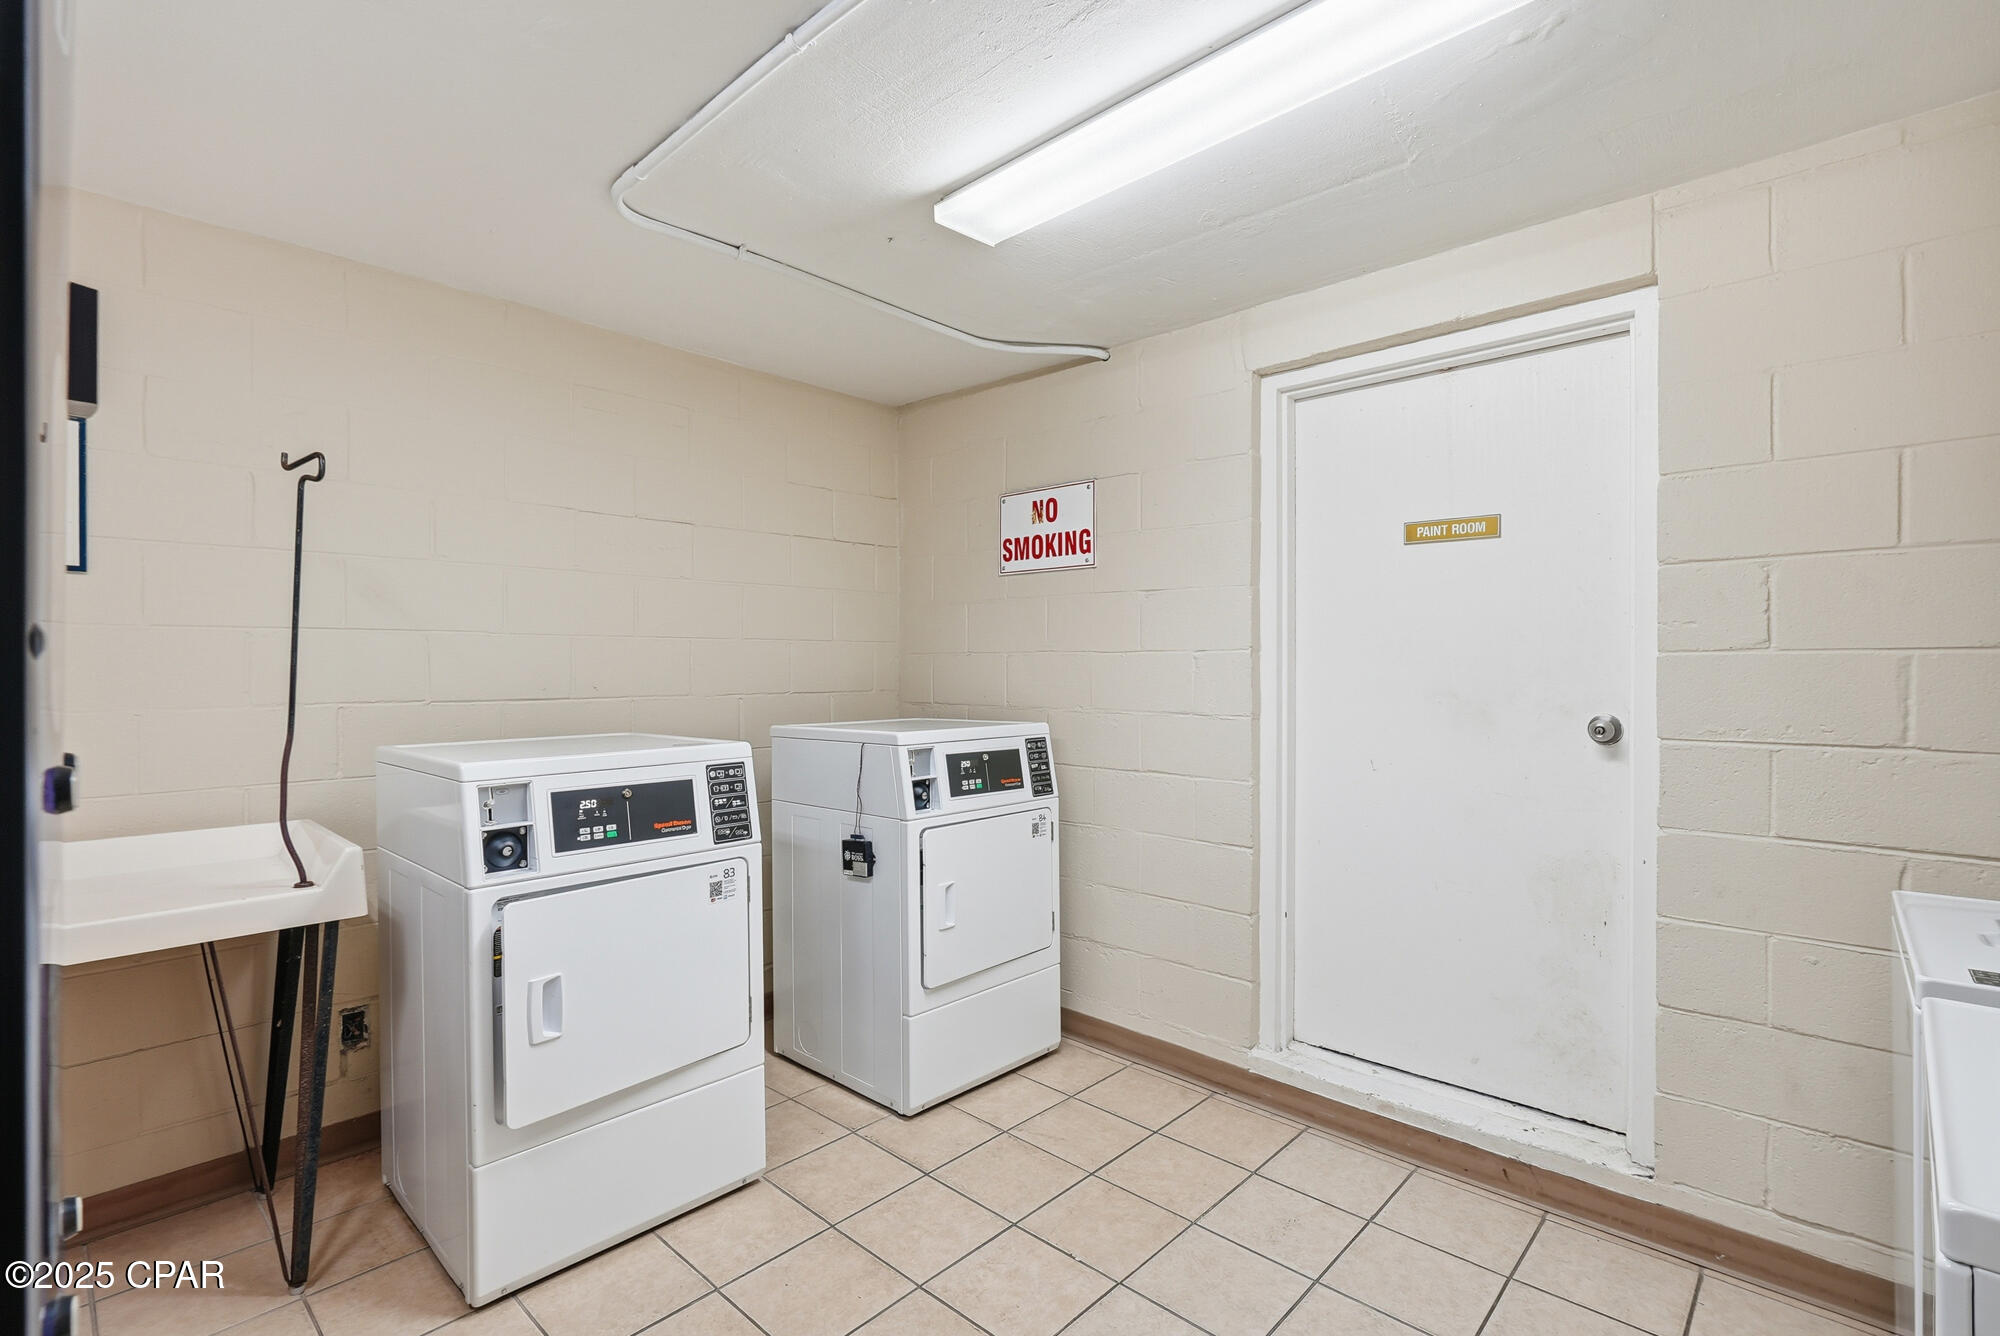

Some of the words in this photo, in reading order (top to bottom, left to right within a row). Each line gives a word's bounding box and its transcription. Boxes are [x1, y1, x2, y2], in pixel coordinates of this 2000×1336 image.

[1032, 498, 1058, 524] NO
[1416, 525, 1448, 537] PAINT
[1452, 521, 1486, 535] ROOM
[1003, 529, 1091, 562] SMOKING
[723, 867, 735, 879] 83
